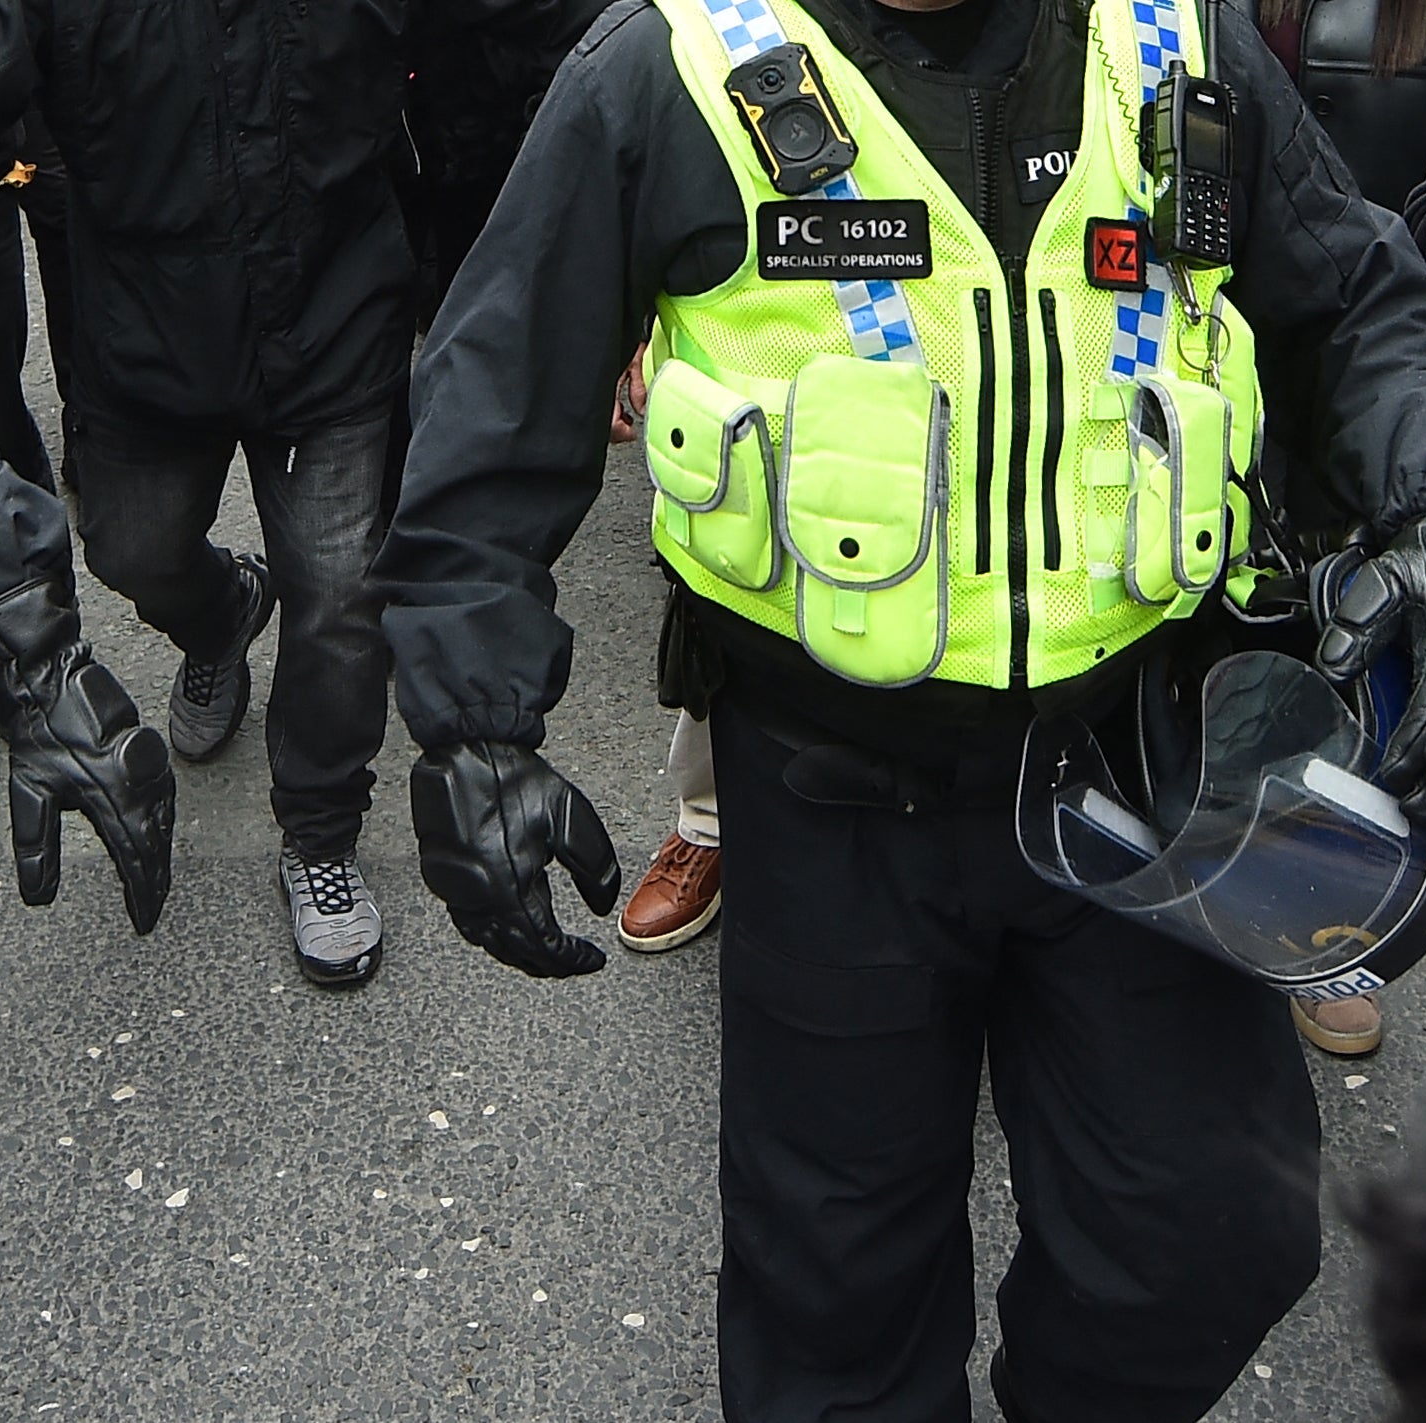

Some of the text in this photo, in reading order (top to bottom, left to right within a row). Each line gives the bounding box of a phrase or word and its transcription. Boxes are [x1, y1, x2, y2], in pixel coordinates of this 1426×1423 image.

[778, 215, 908, 246] PC 16102
[766, 253, 923, 268] SPECIALIST OPERATIONS
[1097, 237, 1136, 271] XZ
